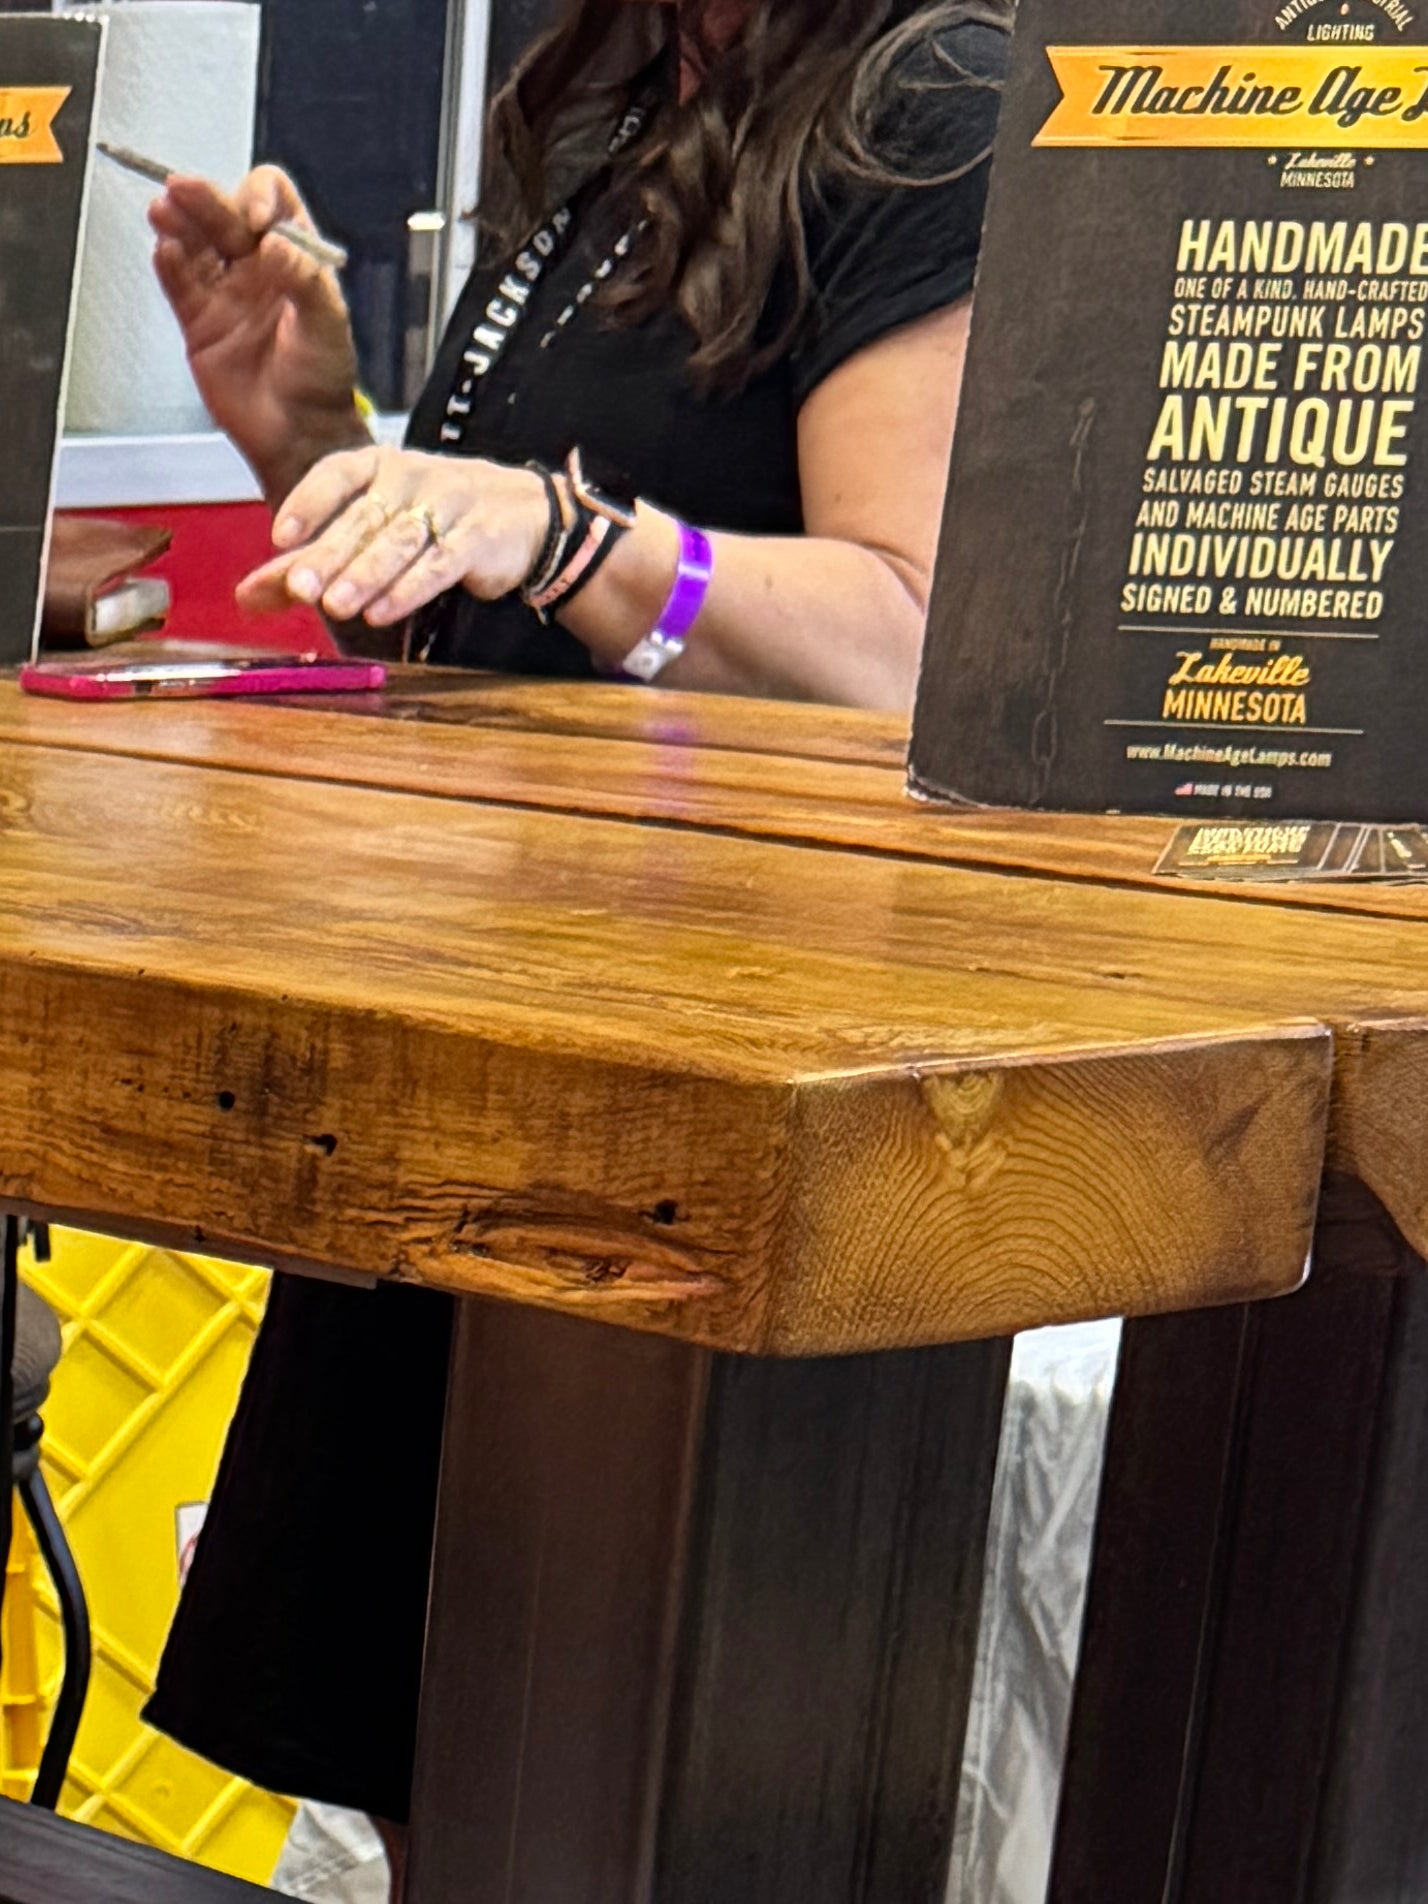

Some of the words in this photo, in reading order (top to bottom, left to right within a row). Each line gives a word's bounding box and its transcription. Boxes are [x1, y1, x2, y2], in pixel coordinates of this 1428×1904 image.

[1307, 23, 1375, 42] LIGHTING
[1092, 65, 1304, 115] Machine
[1308, 65, 1404, 128] Age
[1280, 170, 1355, 188] MINNESOTA
[1174, 276, 1206, 299] ONE
[1211, 277, 1234, 299] OF
[1236, 278, 1249, 300] A
[1168, 304, 1326, 337] STEAMPUNK
[1335, 305, 1426, 340] LAMPS
[1159, 341, 1283, 390] MADE
[1294, 343, 1422, 393] FROM
[1146, 394, 1415, 468] ANTIQUE
[1142, 466, 1243, 494] SALVAGED
[1250, 470, 1317, 497] STEAM
[1323, 471, 1405, 499] GAUGES
[1135, 500, 1180, 528] AND
[1185, 501, 1281, 531] MACHINE
[1284, 504, 1328, 533] AGE
[1333, 505, 1400, 534] PARTS
[1128, 532, 1394, 583] INDIVIDUALLY
[1120, 583, 1212, 614] SIGNED
[1218, 586, 1237, 615] &
[1244, 587, 1384, 619] NUMBERED
[1168, 651, 1311, 686] Lakeville
[1162, 688, 1306, 724] MINNESOTA
